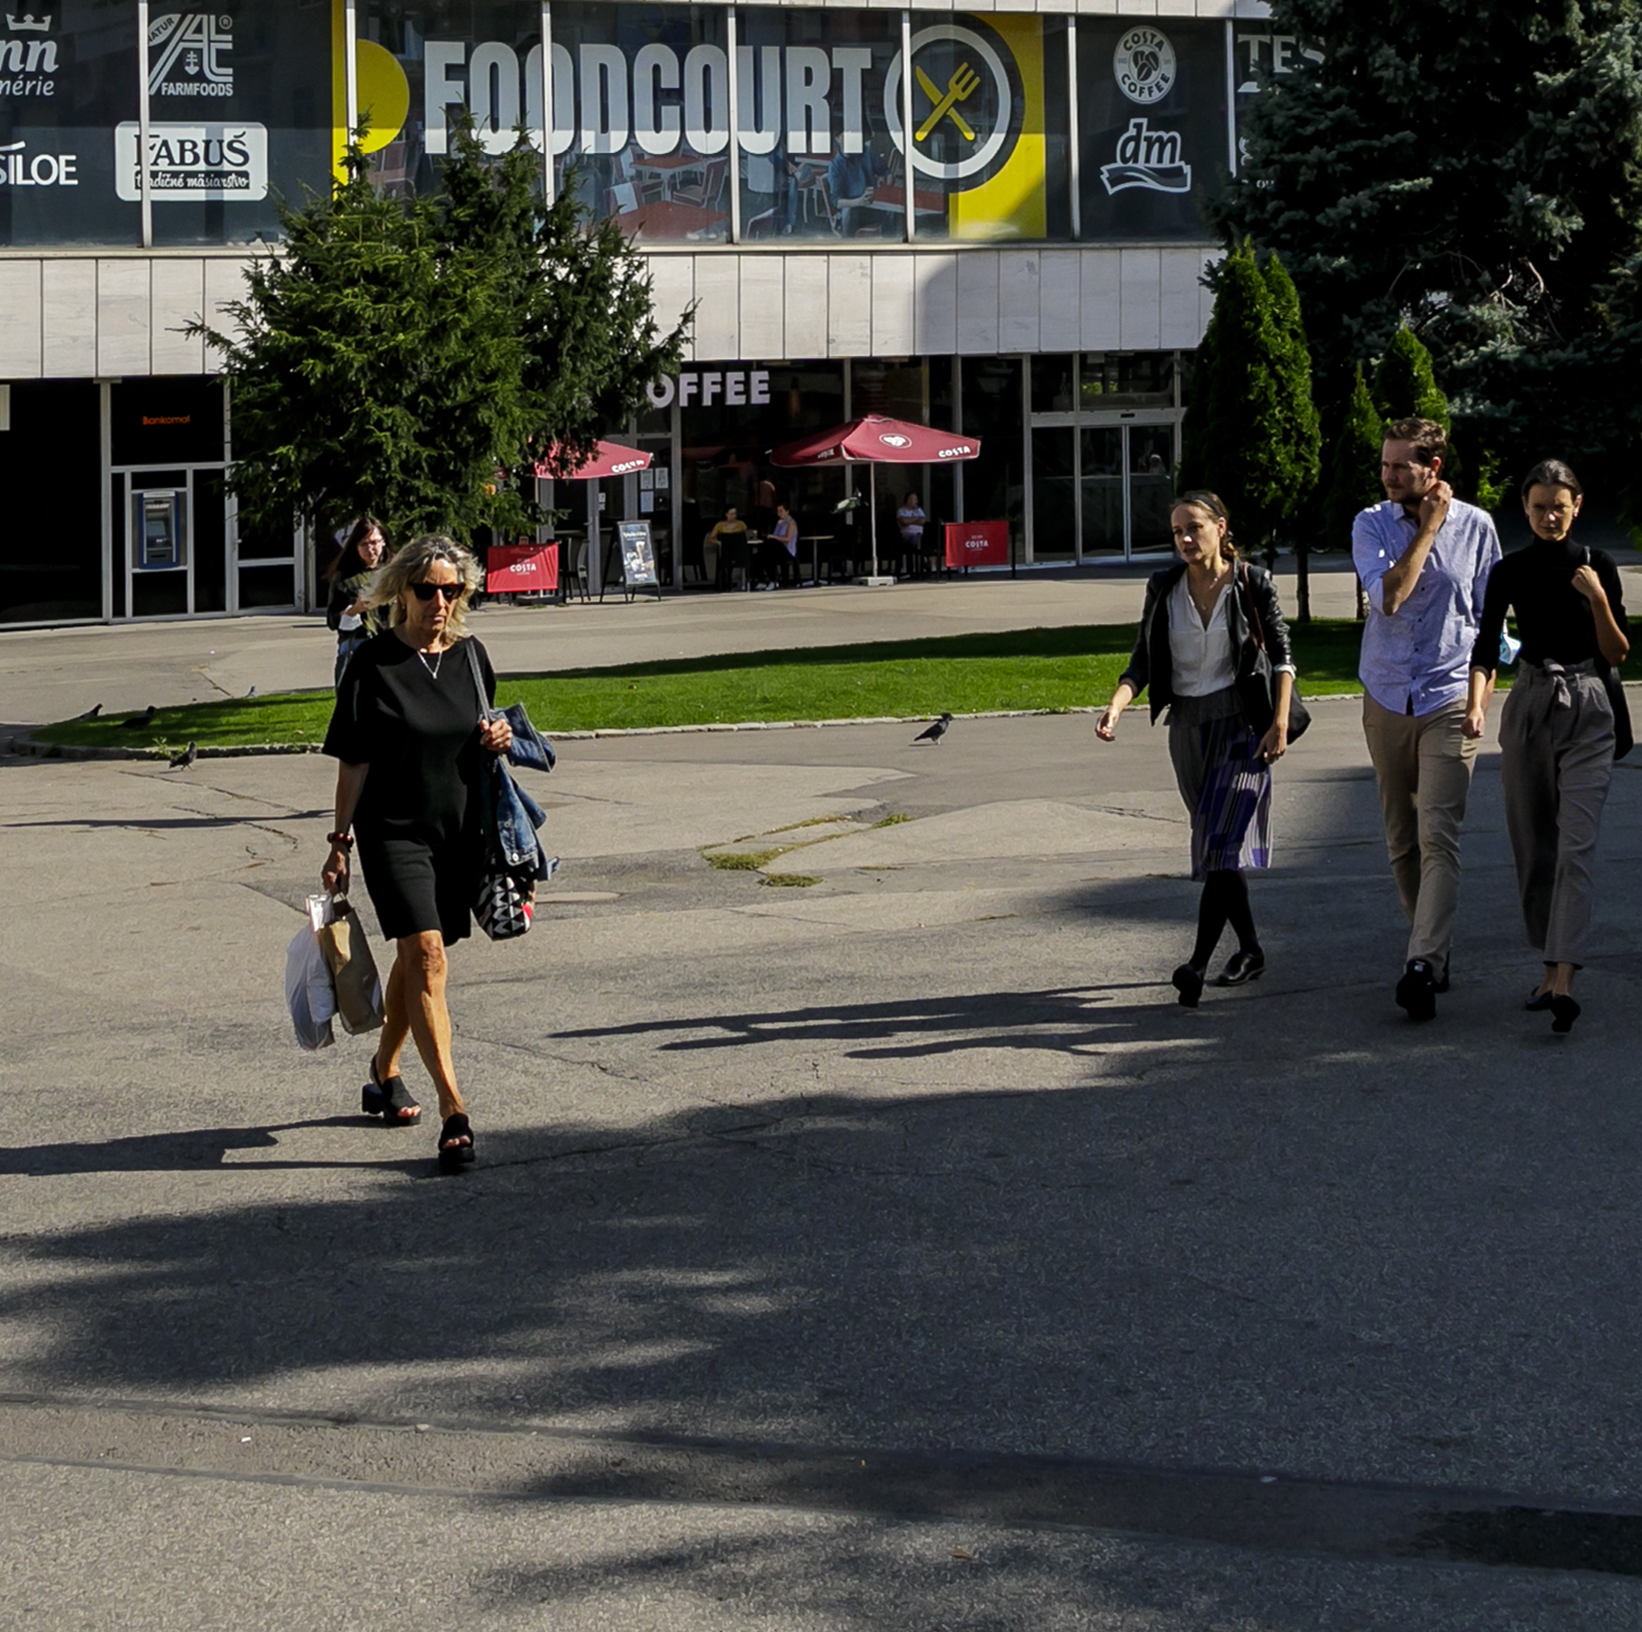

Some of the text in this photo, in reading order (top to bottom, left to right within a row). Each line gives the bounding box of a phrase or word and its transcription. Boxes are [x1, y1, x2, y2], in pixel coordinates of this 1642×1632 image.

[1123, 30, 1165, 52] COSTA
[1237, 34, 1326, 74] TES
[161, 82, 234, 96] FARMFOODS
[1120, 73, 1170, 98] COFFEE
[424, 41, 872, 155] FOODCOURT
[1116, 118, 1181, 165] dm
[646, 370, 771, 408] OFFEE
[938, 445, 972, 458] COSTA
[965, 540, 989, 549] COSTA
[509, 562, 537, 573] COSTA
